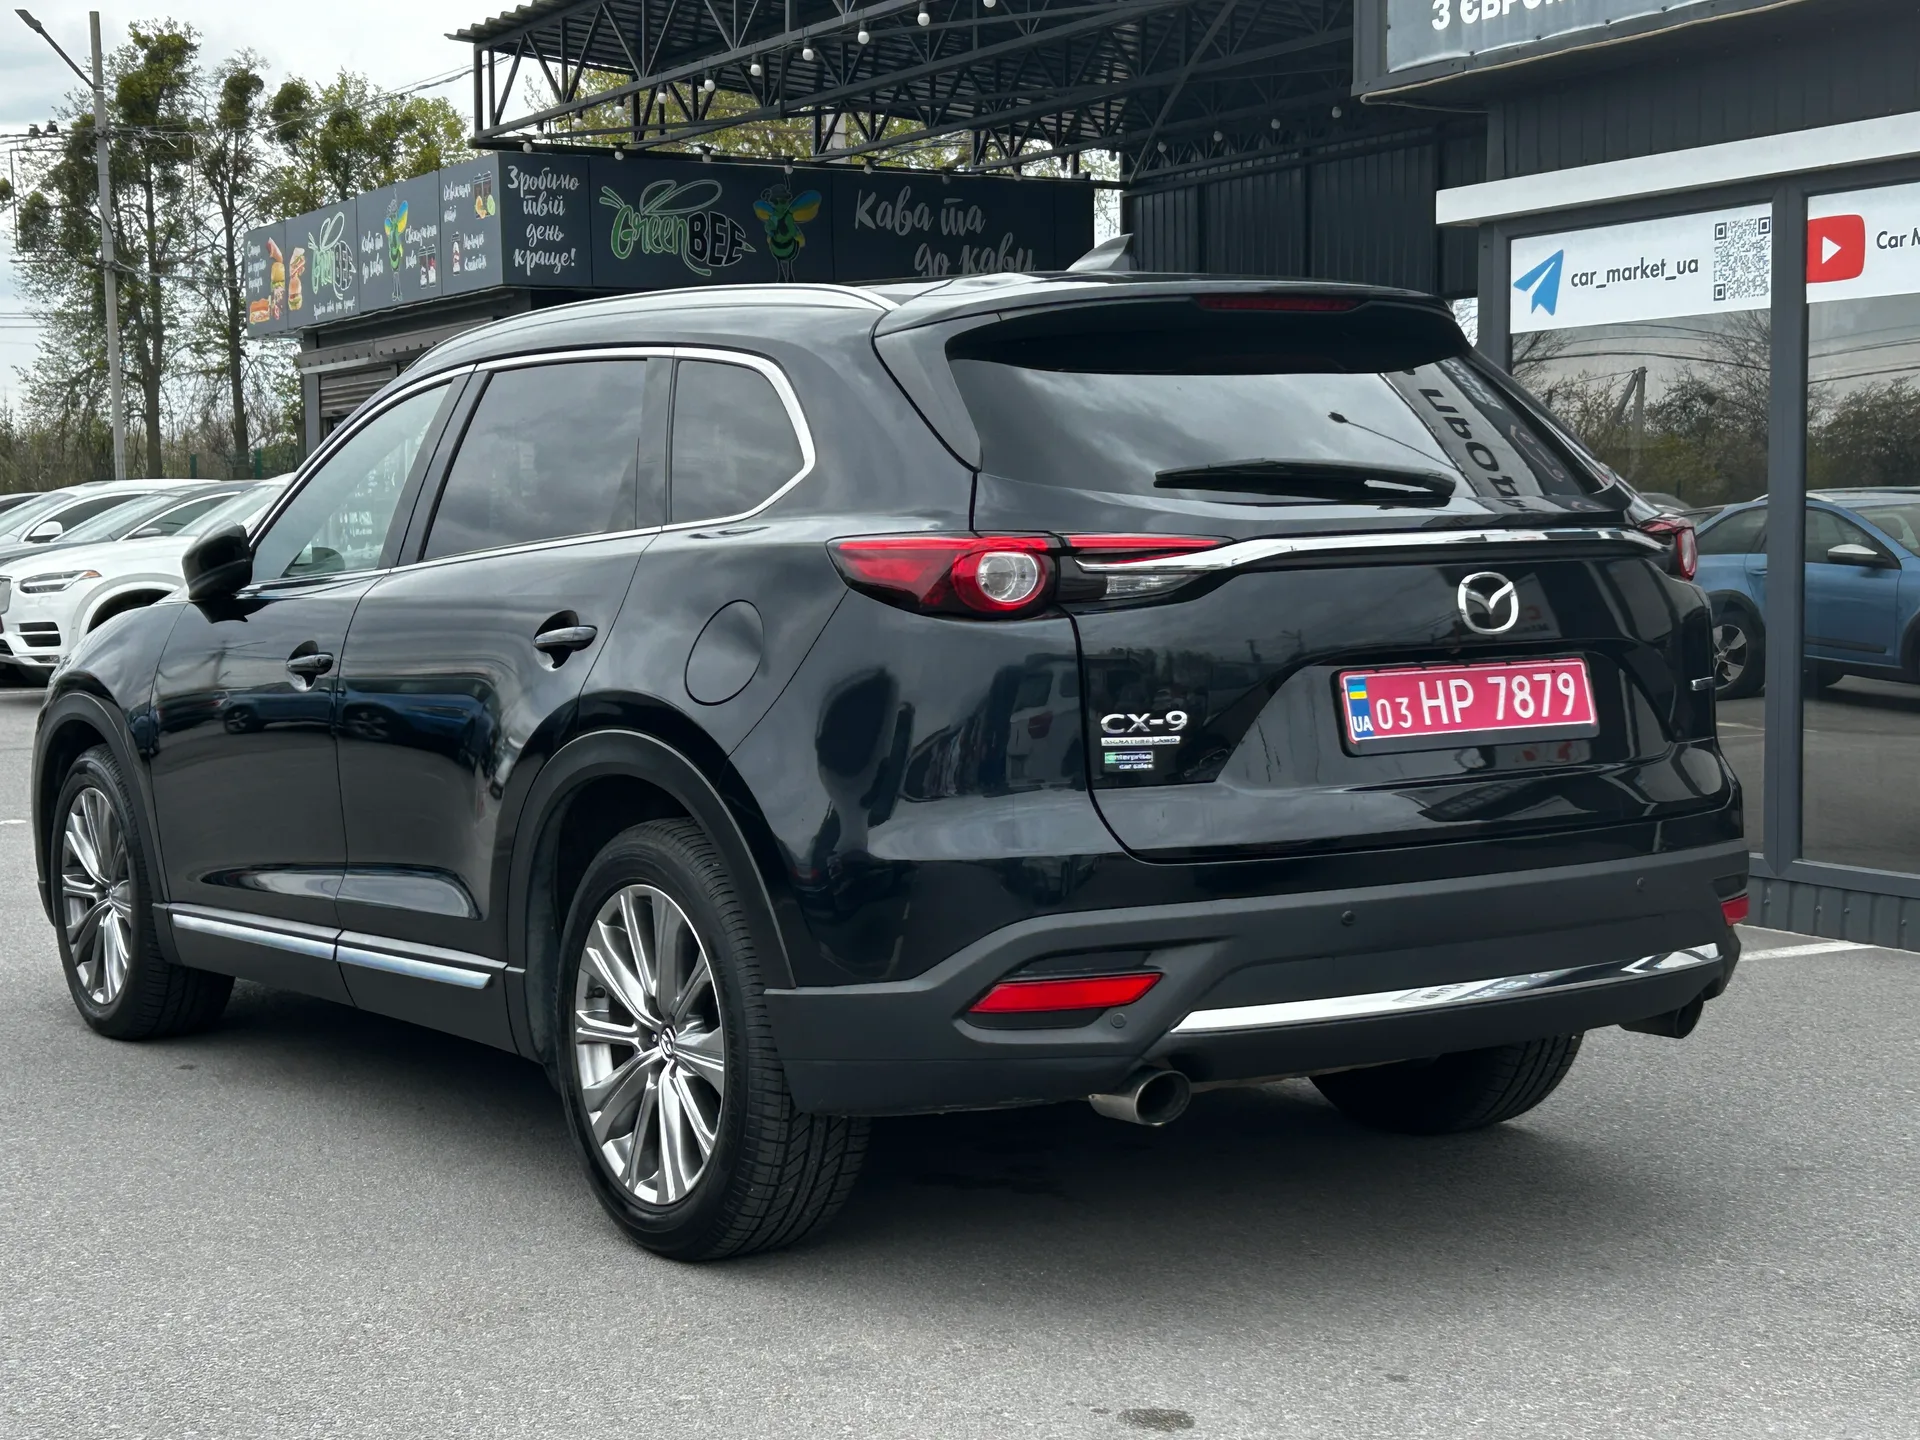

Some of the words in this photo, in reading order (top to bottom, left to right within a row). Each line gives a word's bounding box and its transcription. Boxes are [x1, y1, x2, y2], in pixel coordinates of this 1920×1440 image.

[507, 165, 580, 197] Зробимо
[523, 189, 566, 217] твій
[855, 185, 934, 236] Кава
[940, 198, 987, 236] та
[526, 223, 564, 247] день
[1876, 230, 1908, 250] Car
[514, 248, 577, 276] краще!
[1571, 256, 1700, 289] car_market_ua
[1376, 697, 1412, 730] 03
[1418, 679, 1474, 725] HP
[1487, 672, 1576, 721] 7879
[1100, 710, 1188, 734] CX-9
[1353, 715, 1374, 733] UA
